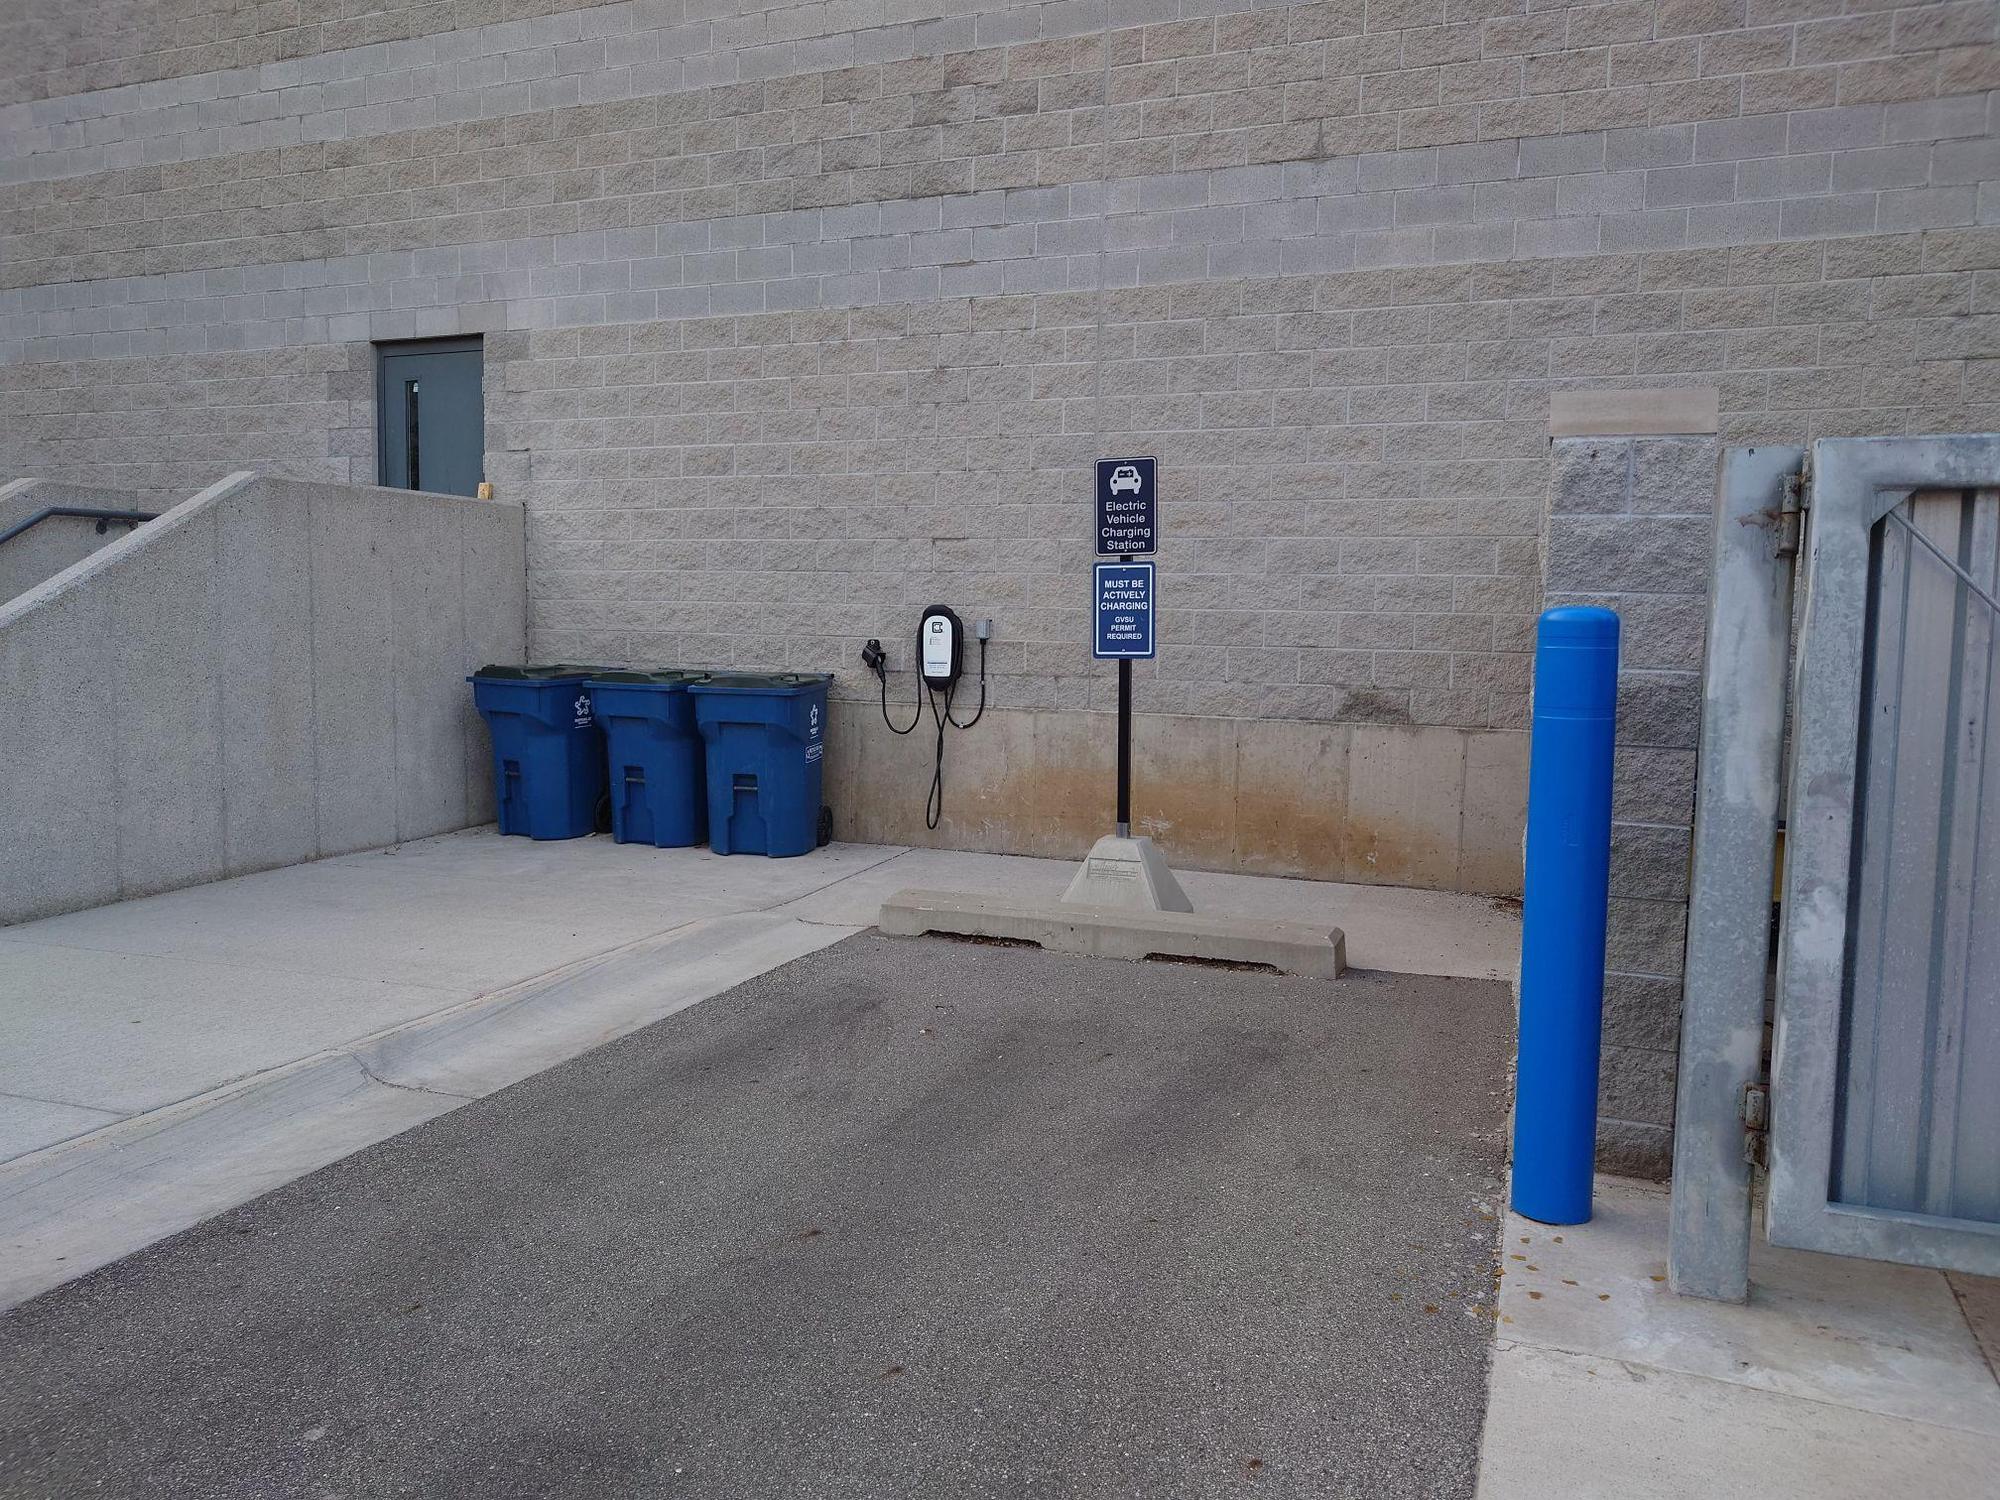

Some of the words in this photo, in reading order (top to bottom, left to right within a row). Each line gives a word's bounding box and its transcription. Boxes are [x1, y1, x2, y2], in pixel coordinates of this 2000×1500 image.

[1105, 501, 1146, 511] Electric
[1106, 513, 1145, 524] Vehicle
[1101, 527, 1150, 538] Charging
[1107, 540, 1145, 550] Station
[1104, 580, 1129, 588] MUST
[1131, 580, 1144, 588] BE
[1103, 591, 1145, 599] ACTIVELY
[1100, 602, 1148, 610] CHARGING
